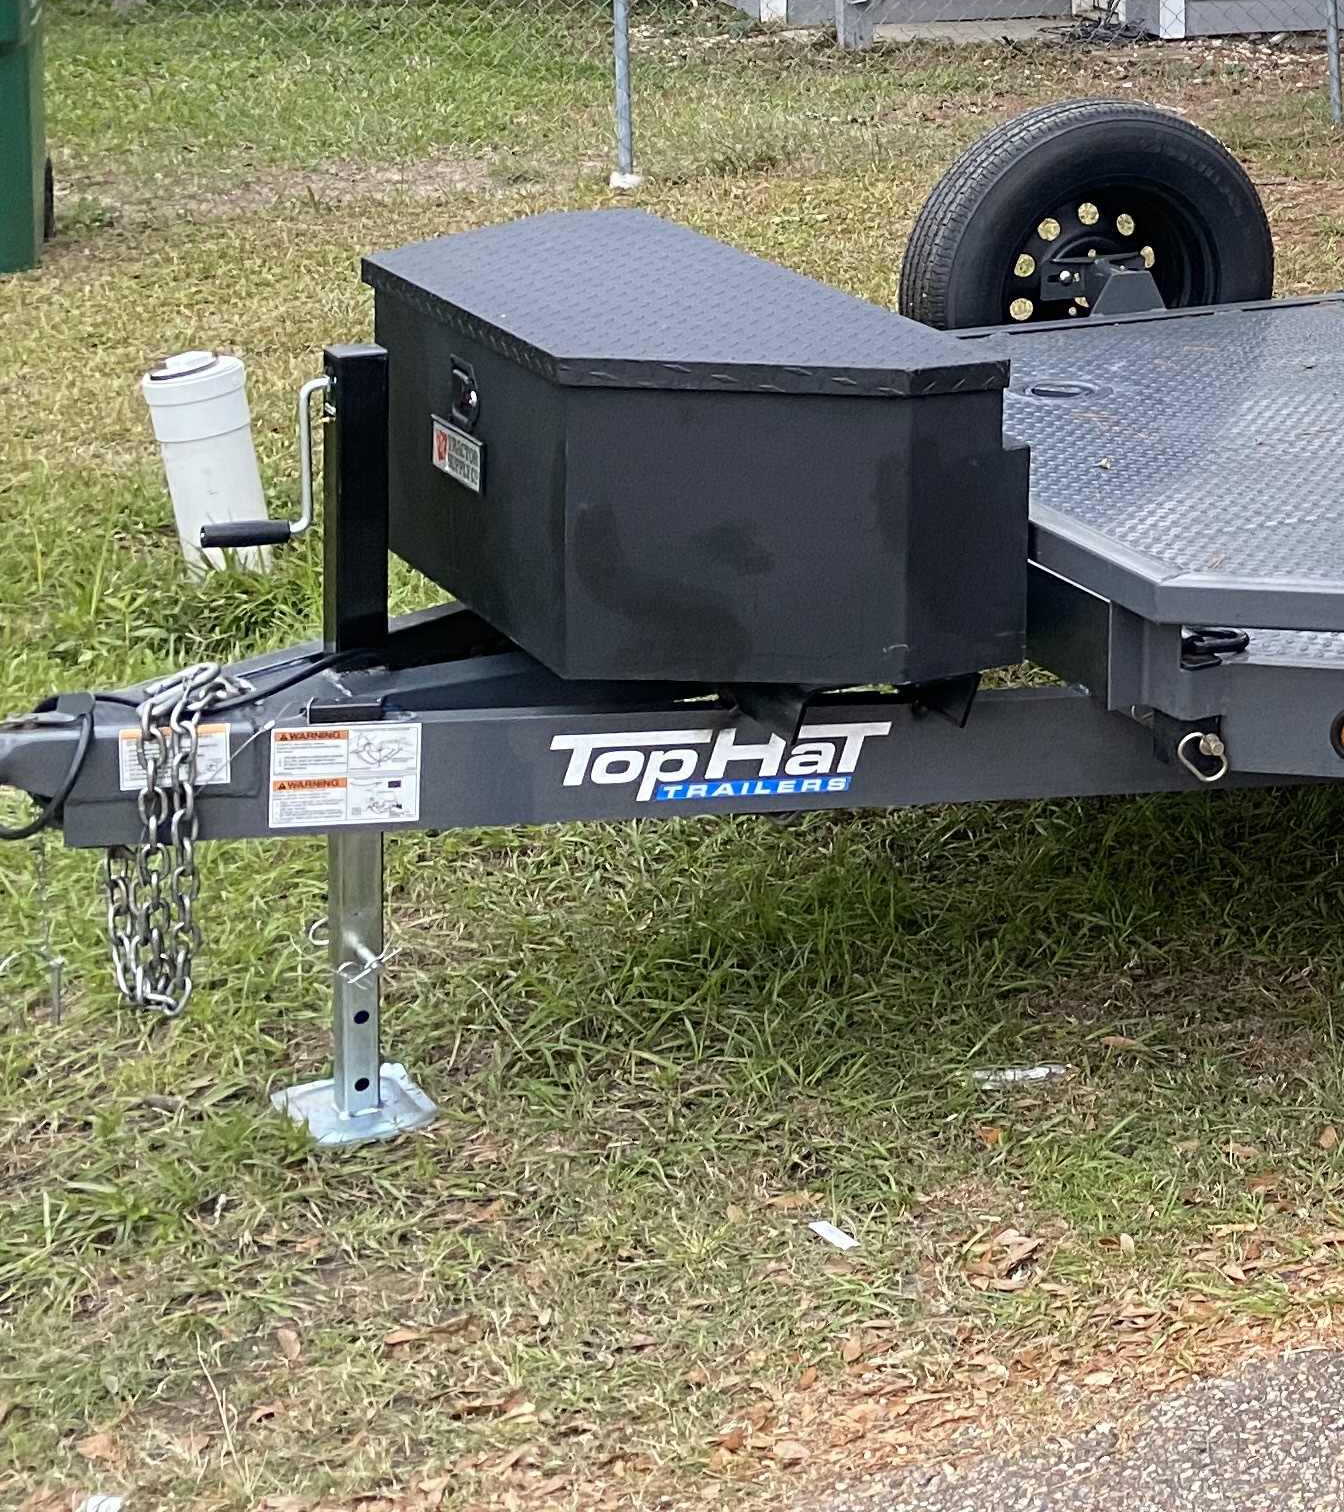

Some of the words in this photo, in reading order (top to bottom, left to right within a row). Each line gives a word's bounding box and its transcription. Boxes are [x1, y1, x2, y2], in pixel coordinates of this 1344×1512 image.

[290, 730, 341, 741] WARNING
[288, 778, 340, 789] WARNING
[663, 777, 848, 799] TRAILERS
